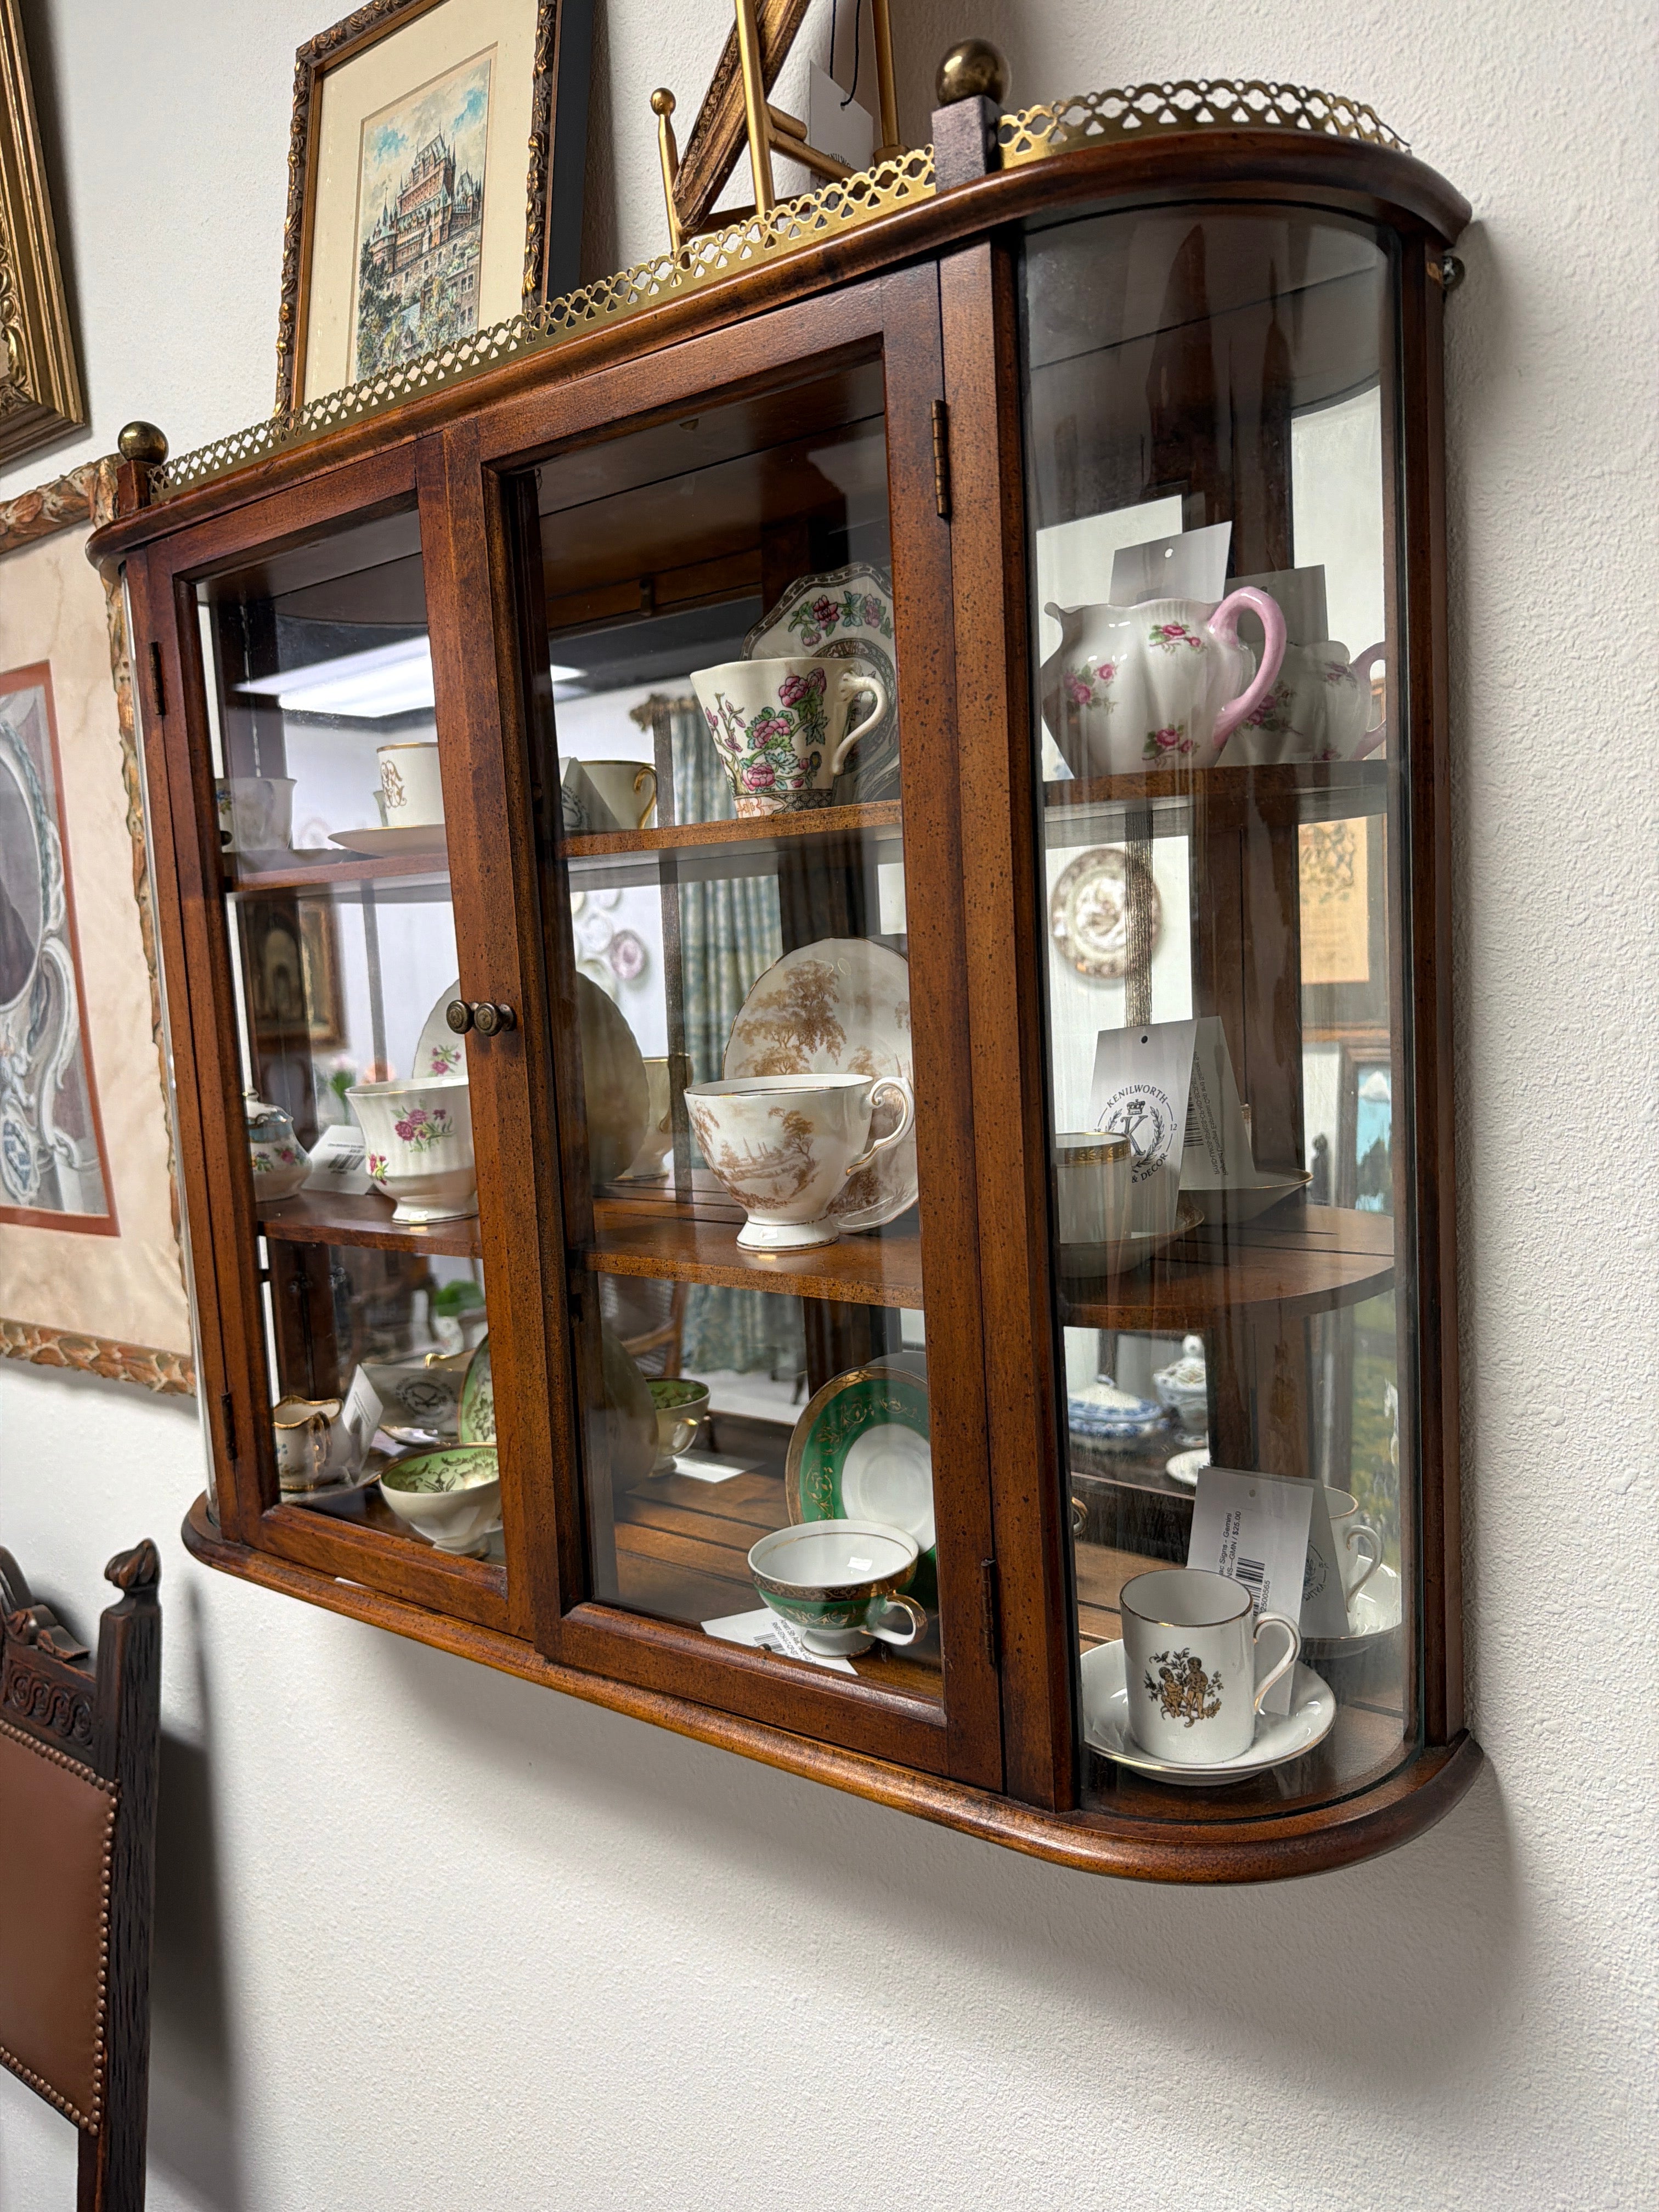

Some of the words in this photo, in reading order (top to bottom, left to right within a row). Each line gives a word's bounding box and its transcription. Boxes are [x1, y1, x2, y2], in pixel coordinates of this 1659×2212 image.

[1107, 1084, 1168, 1108] KENILWORTH
[1131, 1175, 1138, 1183] &
[1140, 1153, 1169, 1181] DECOR
[1223, 1513, 1232, 1538] Gemini
[1232, 1511, 1241, 1535] $25.00
[1220, 1544, 1228, 1564] Signs
[1260, 1580, 1271, 1612] 2500565
